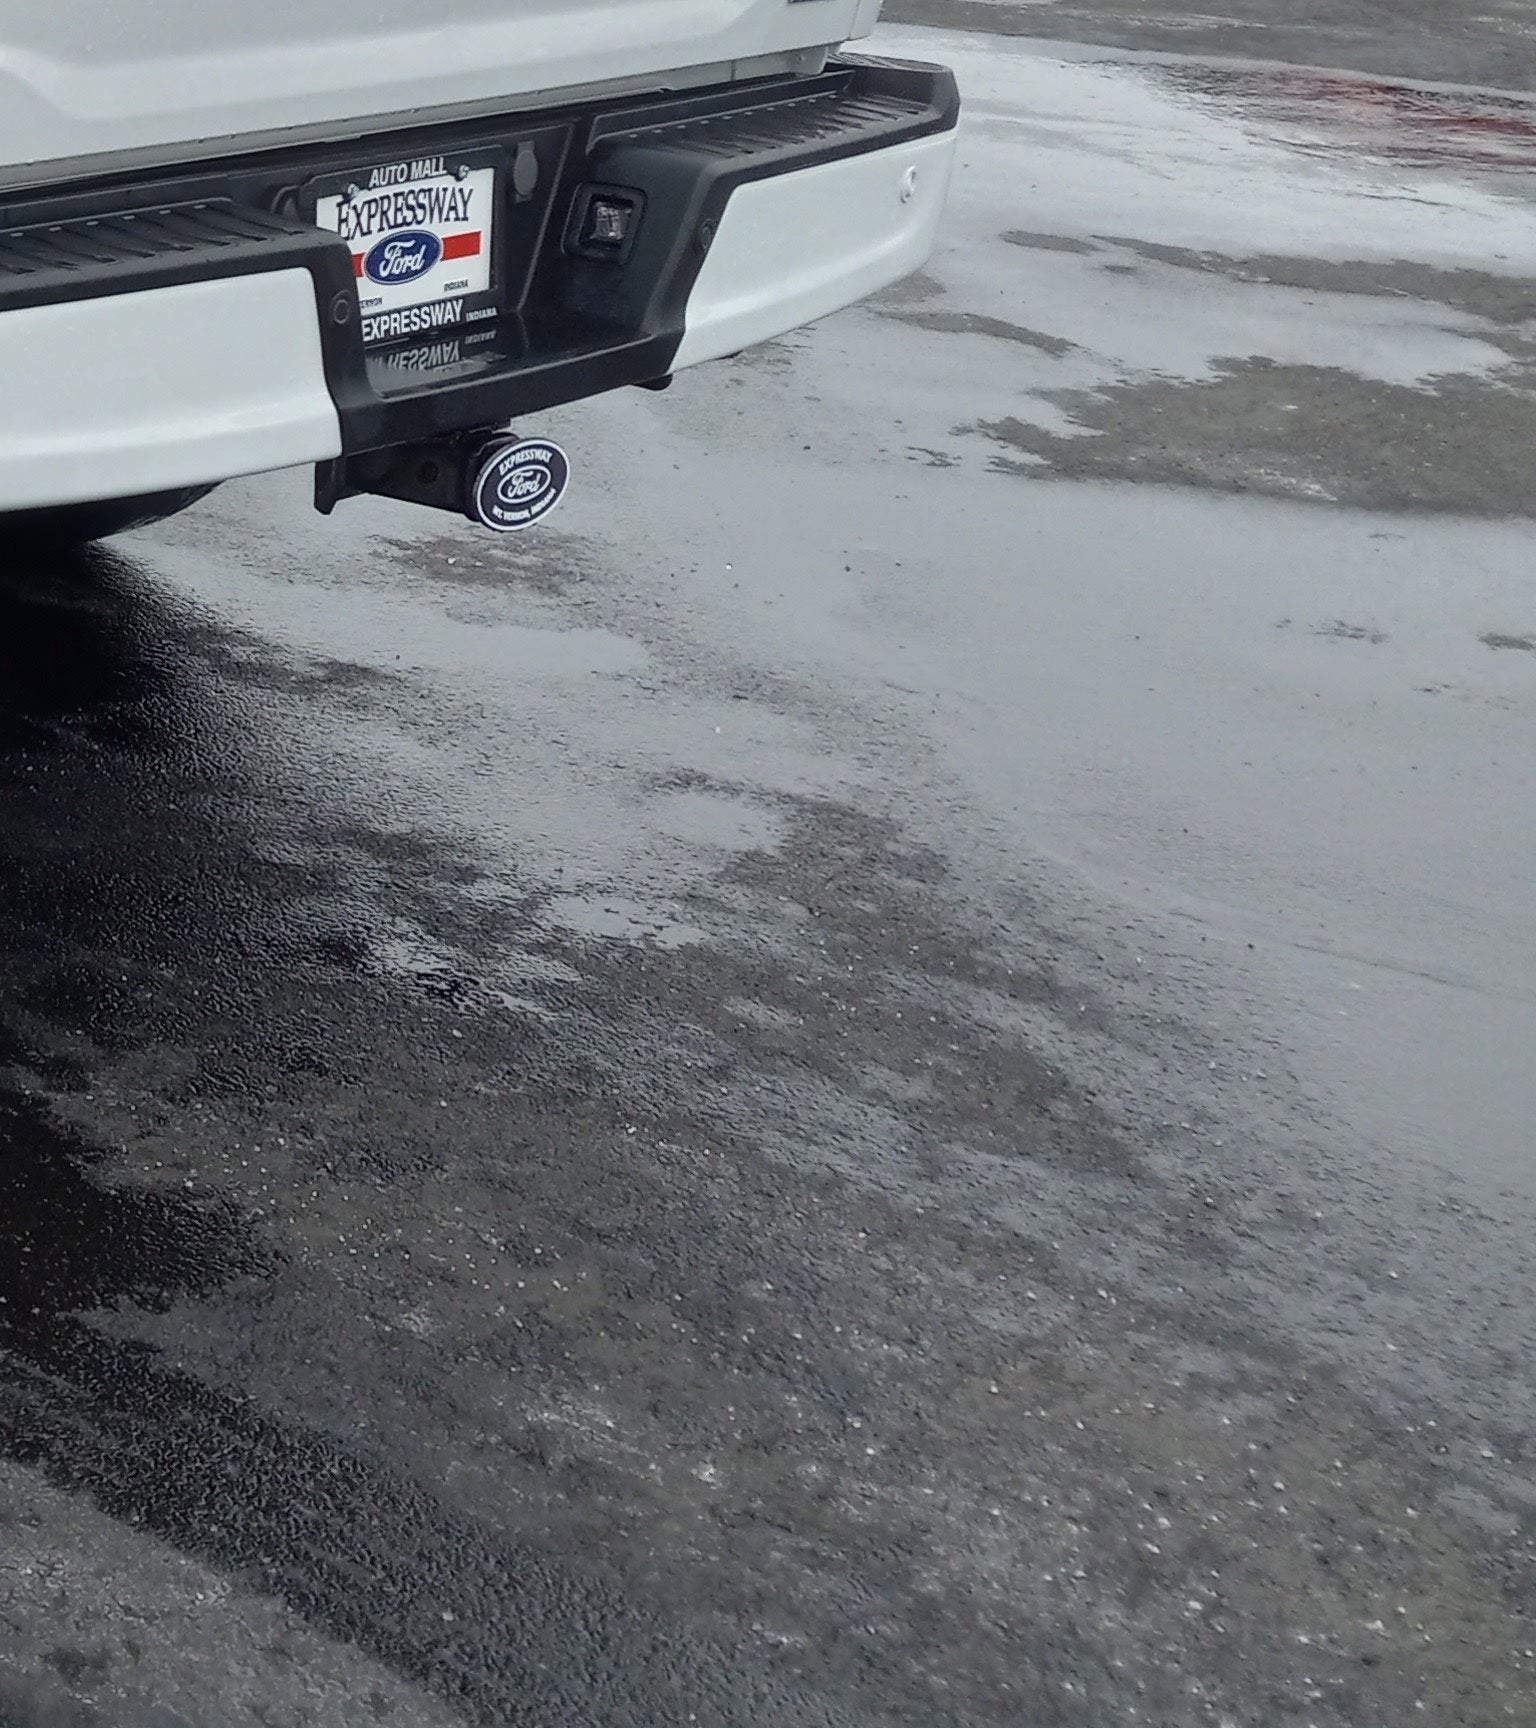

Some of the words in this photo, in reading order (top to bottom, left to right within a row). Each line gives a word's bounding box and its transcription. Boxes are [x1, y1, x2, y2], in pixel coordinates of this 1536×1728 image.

[368, 163, 409, 188] AUTO
[410, 156, 447, 180] MALL
[336, 186, 474, 241] EXPRESSWAY
[379, 238, 425, 277] Ford
[361, 298, 463, 342] EXPRESSWAY
[499, 448, 552, 476] EXPRESSWAY
[508, 470, 541, 498] Ford
